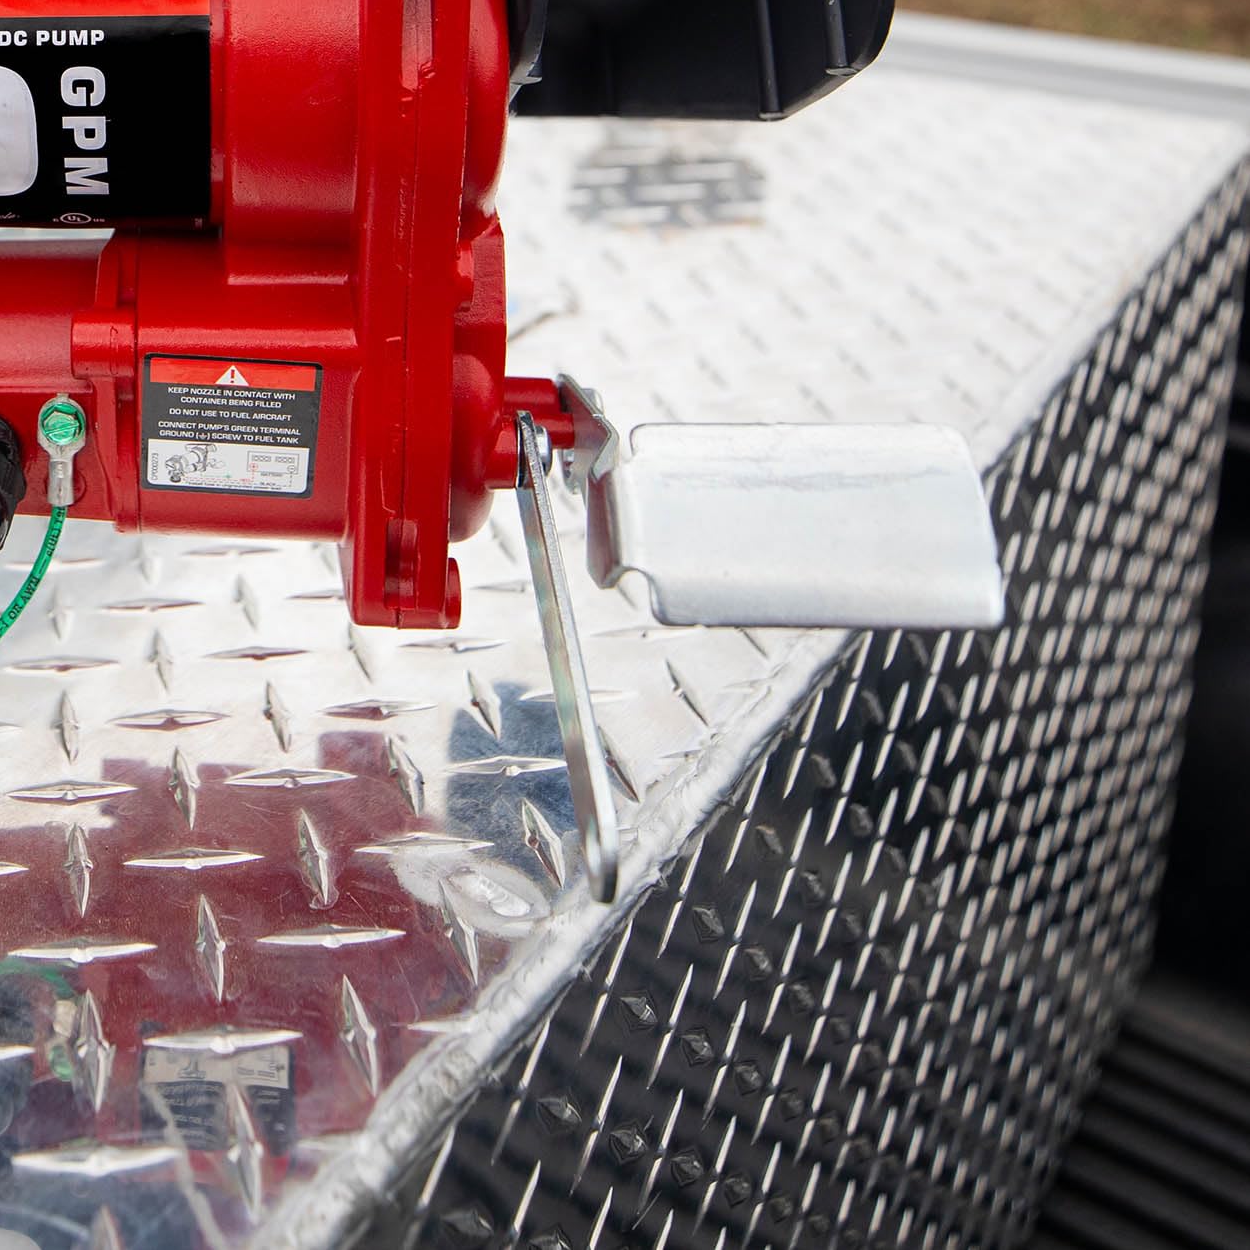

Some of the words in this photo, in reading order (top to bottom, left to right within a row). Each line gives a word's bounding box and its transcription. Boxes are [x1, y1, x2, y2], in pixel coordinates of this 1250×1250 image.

[35, 29, 105, 46] PUMP
[60, 66, 110, 195] GPM
[168, 387, 188, 395] KEEP
[190, 387, 222, 396] NOZZLE
[234, 390, 272, 399] CONTACT
[181, 397, 227, 405] CONTAINER
[229, 399, 253, 407] BEING
[255, 400, 282, 408] FILLED
[252, 413, 292, 421] AIRCRAFT
[158, 421, 197, 429] CONNECT
[198, 423, 229, 431] PUMP'S
[260, 426, 301, 435] TERMINAL
[160, 430, 194, 438] GROUND
[212, 432, 241, 441] SCREW
[276, 436, 299, 444] TANK
[8, 604, 23, 620] OR
